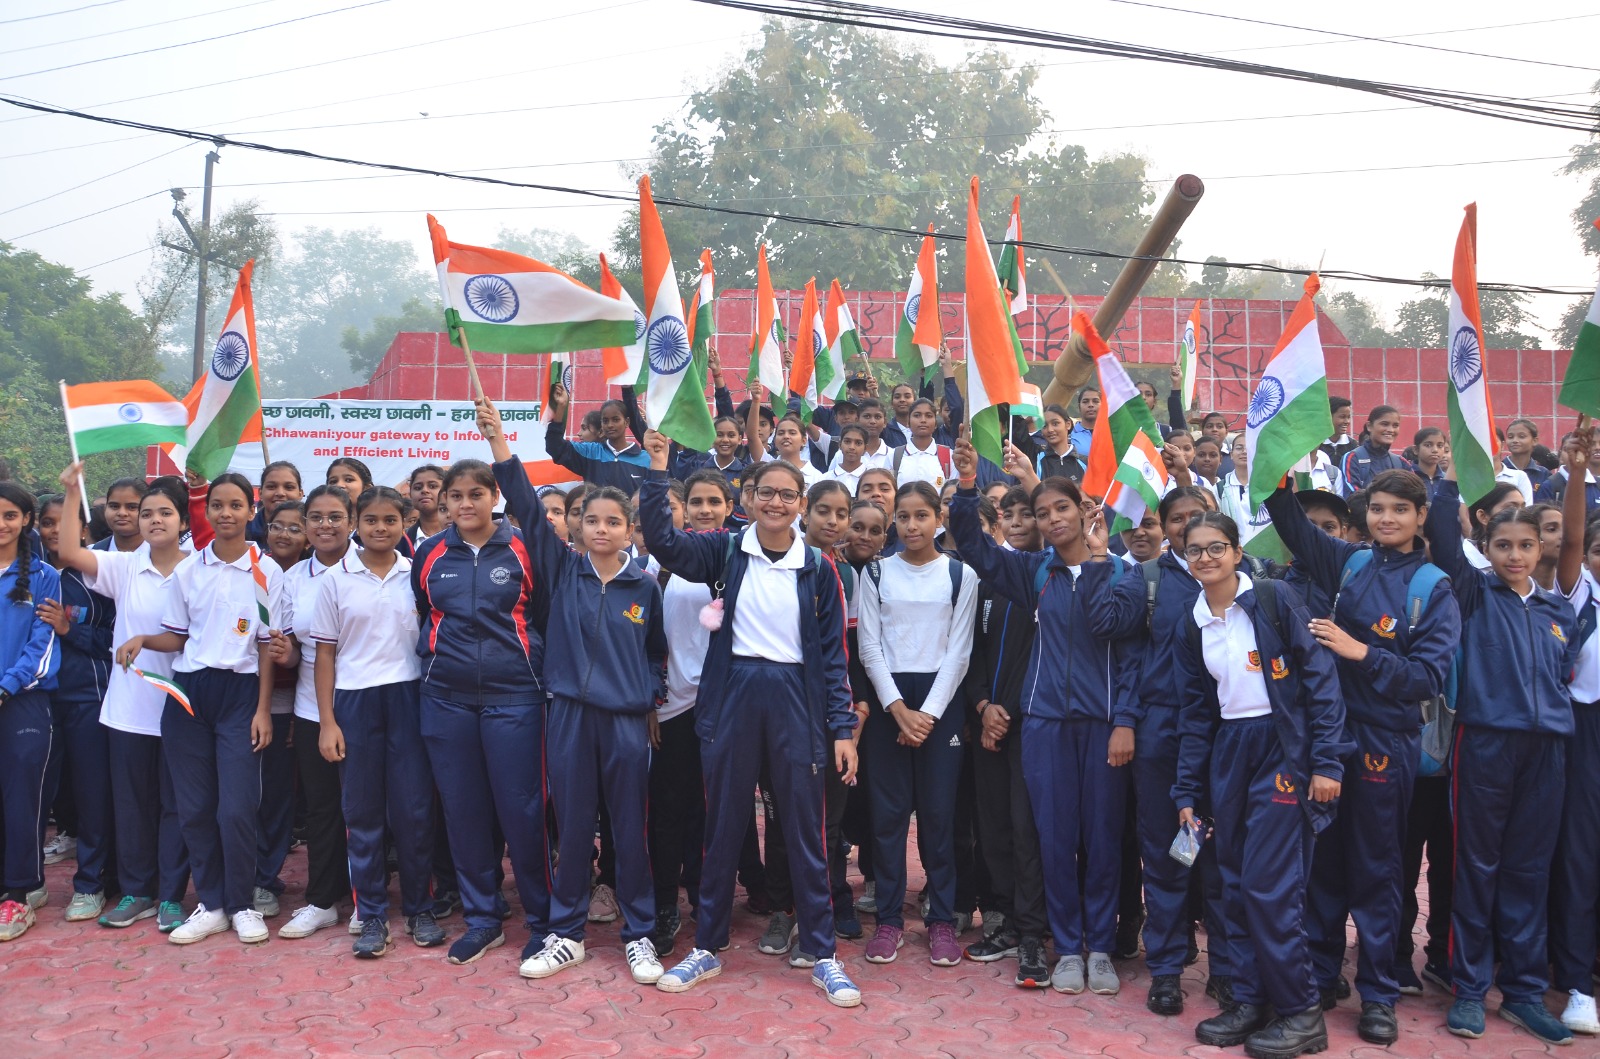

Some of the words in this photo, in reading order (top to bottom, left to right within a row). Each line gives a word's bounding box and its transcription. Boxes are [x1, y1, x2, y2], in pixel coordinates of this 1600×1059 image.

[285, 402, 335, 420] छावनी,
[341, 407, 382, 420] स्वस्थ
[386, 403, 432, 421] छावनी
[370, 430, 431, 443] gateway
[435, 430, 449, 441] to
[453, 430, 518, 441] Infoed
[313, 446, 339, 457] and
[343, 446, 404, 458] Efficient
[408, 447, 450, 460] Living
